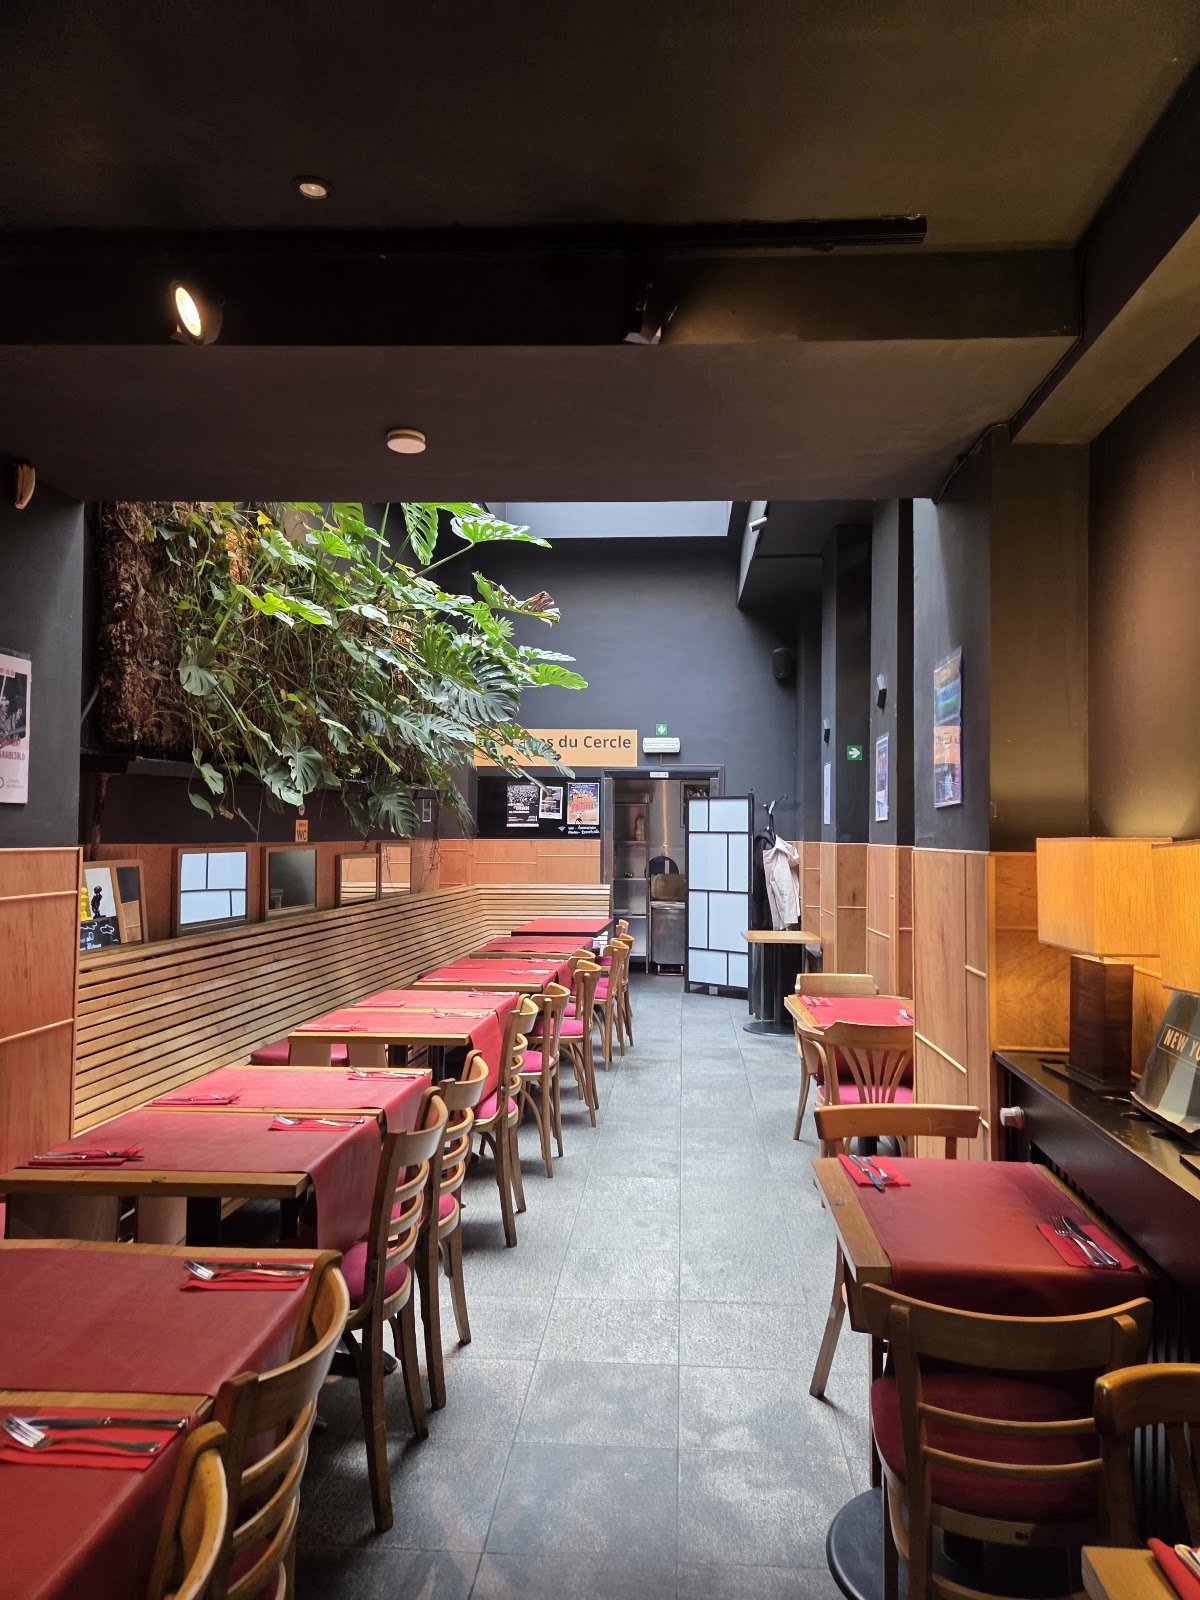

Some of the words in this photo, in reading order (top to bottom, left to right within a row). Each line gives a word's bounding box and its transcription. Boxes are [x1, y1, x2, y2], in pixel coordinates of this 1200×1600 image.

[558, 735, 578, 749] du
[583, 735, 632, 749] Cercle
[296, 829, 308, 841] WC
[1163, 1028, 1189, 1053] NEW
